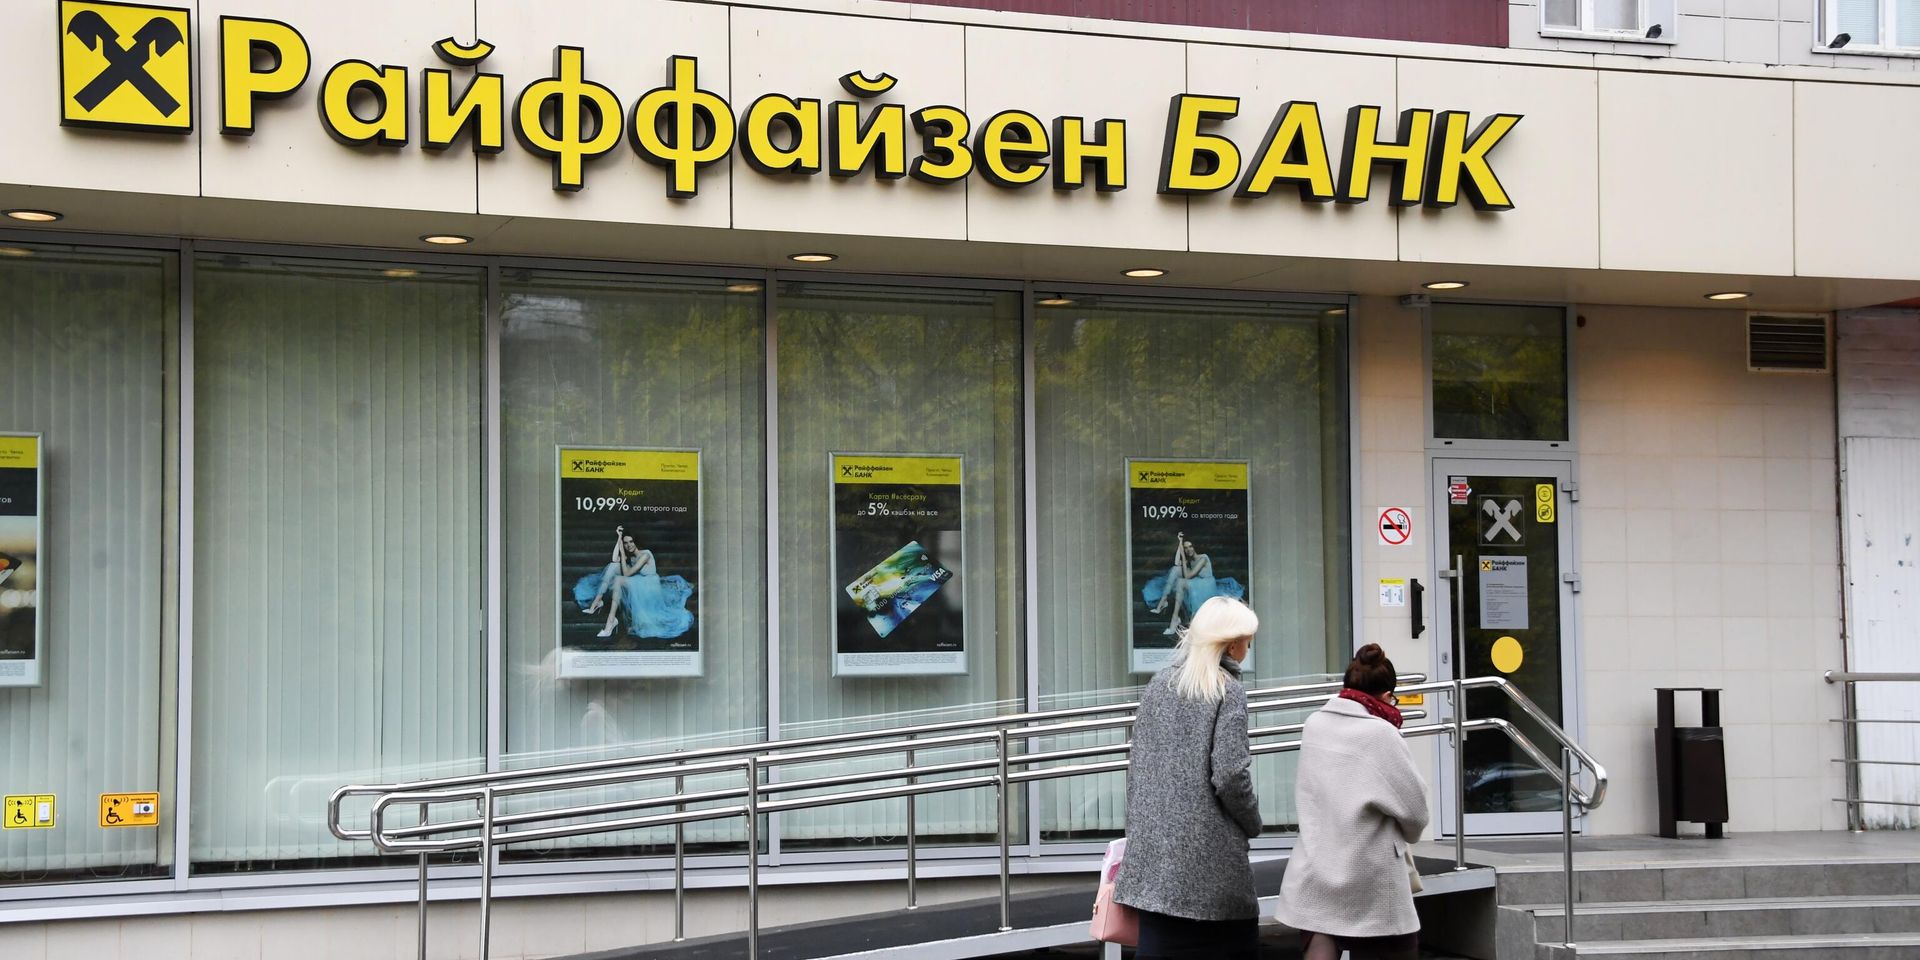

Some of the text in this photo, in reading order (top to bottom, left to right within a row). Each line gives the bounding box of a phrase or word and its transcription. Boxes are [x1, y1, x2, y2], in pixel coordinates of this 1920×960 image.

[219, 15, 1524, 212] Райффайзен БАНК
[618, 487, 644, 497] Кредит
[575, 497, 630, 513] 10,99%
[1178, 496, 1200, 505] Кредит
[867, 502, 890, 516] 5%
[1142, 505, 1188, 520] 10,99%
[929, 567, 946, 582] VISA
